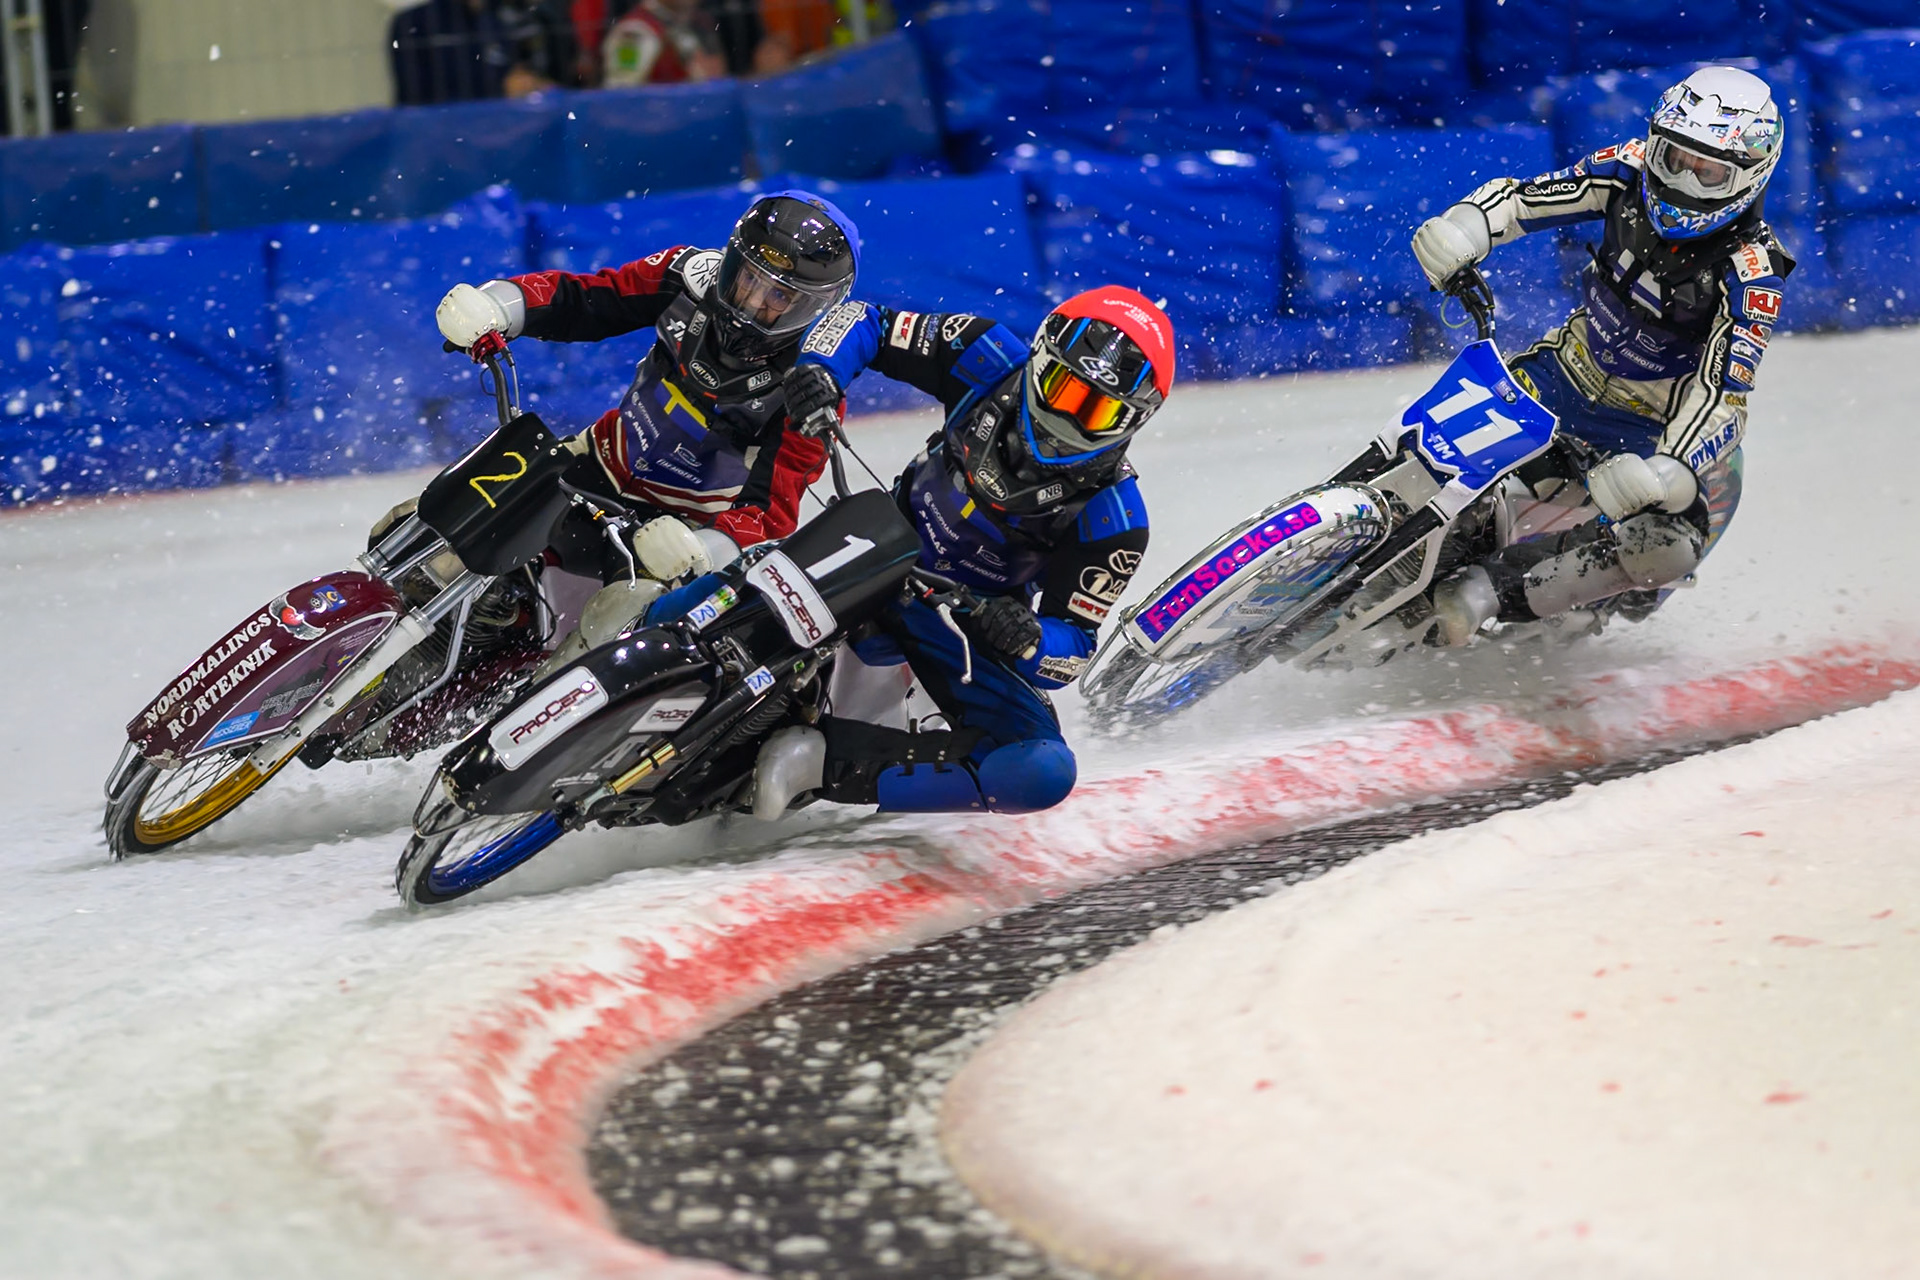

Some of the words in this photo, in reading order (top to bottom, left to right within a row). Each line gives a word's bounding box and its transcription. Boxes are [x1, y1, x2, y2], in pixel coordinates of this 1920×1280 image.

[1426, 377, 1524, 457] 11
[1427, 433, 1456, 460] FIM
[469, 451, 528, 509] 2
[805, 534, 876, 581] 1
[925, 522, 948, 554] ANLAS
[1145, 505, 1320, 633] FunSocks.se
[143, 613, 272, 729] NORDMALINGS
[166, 638, 277, 740] RÖRTEKNIK
